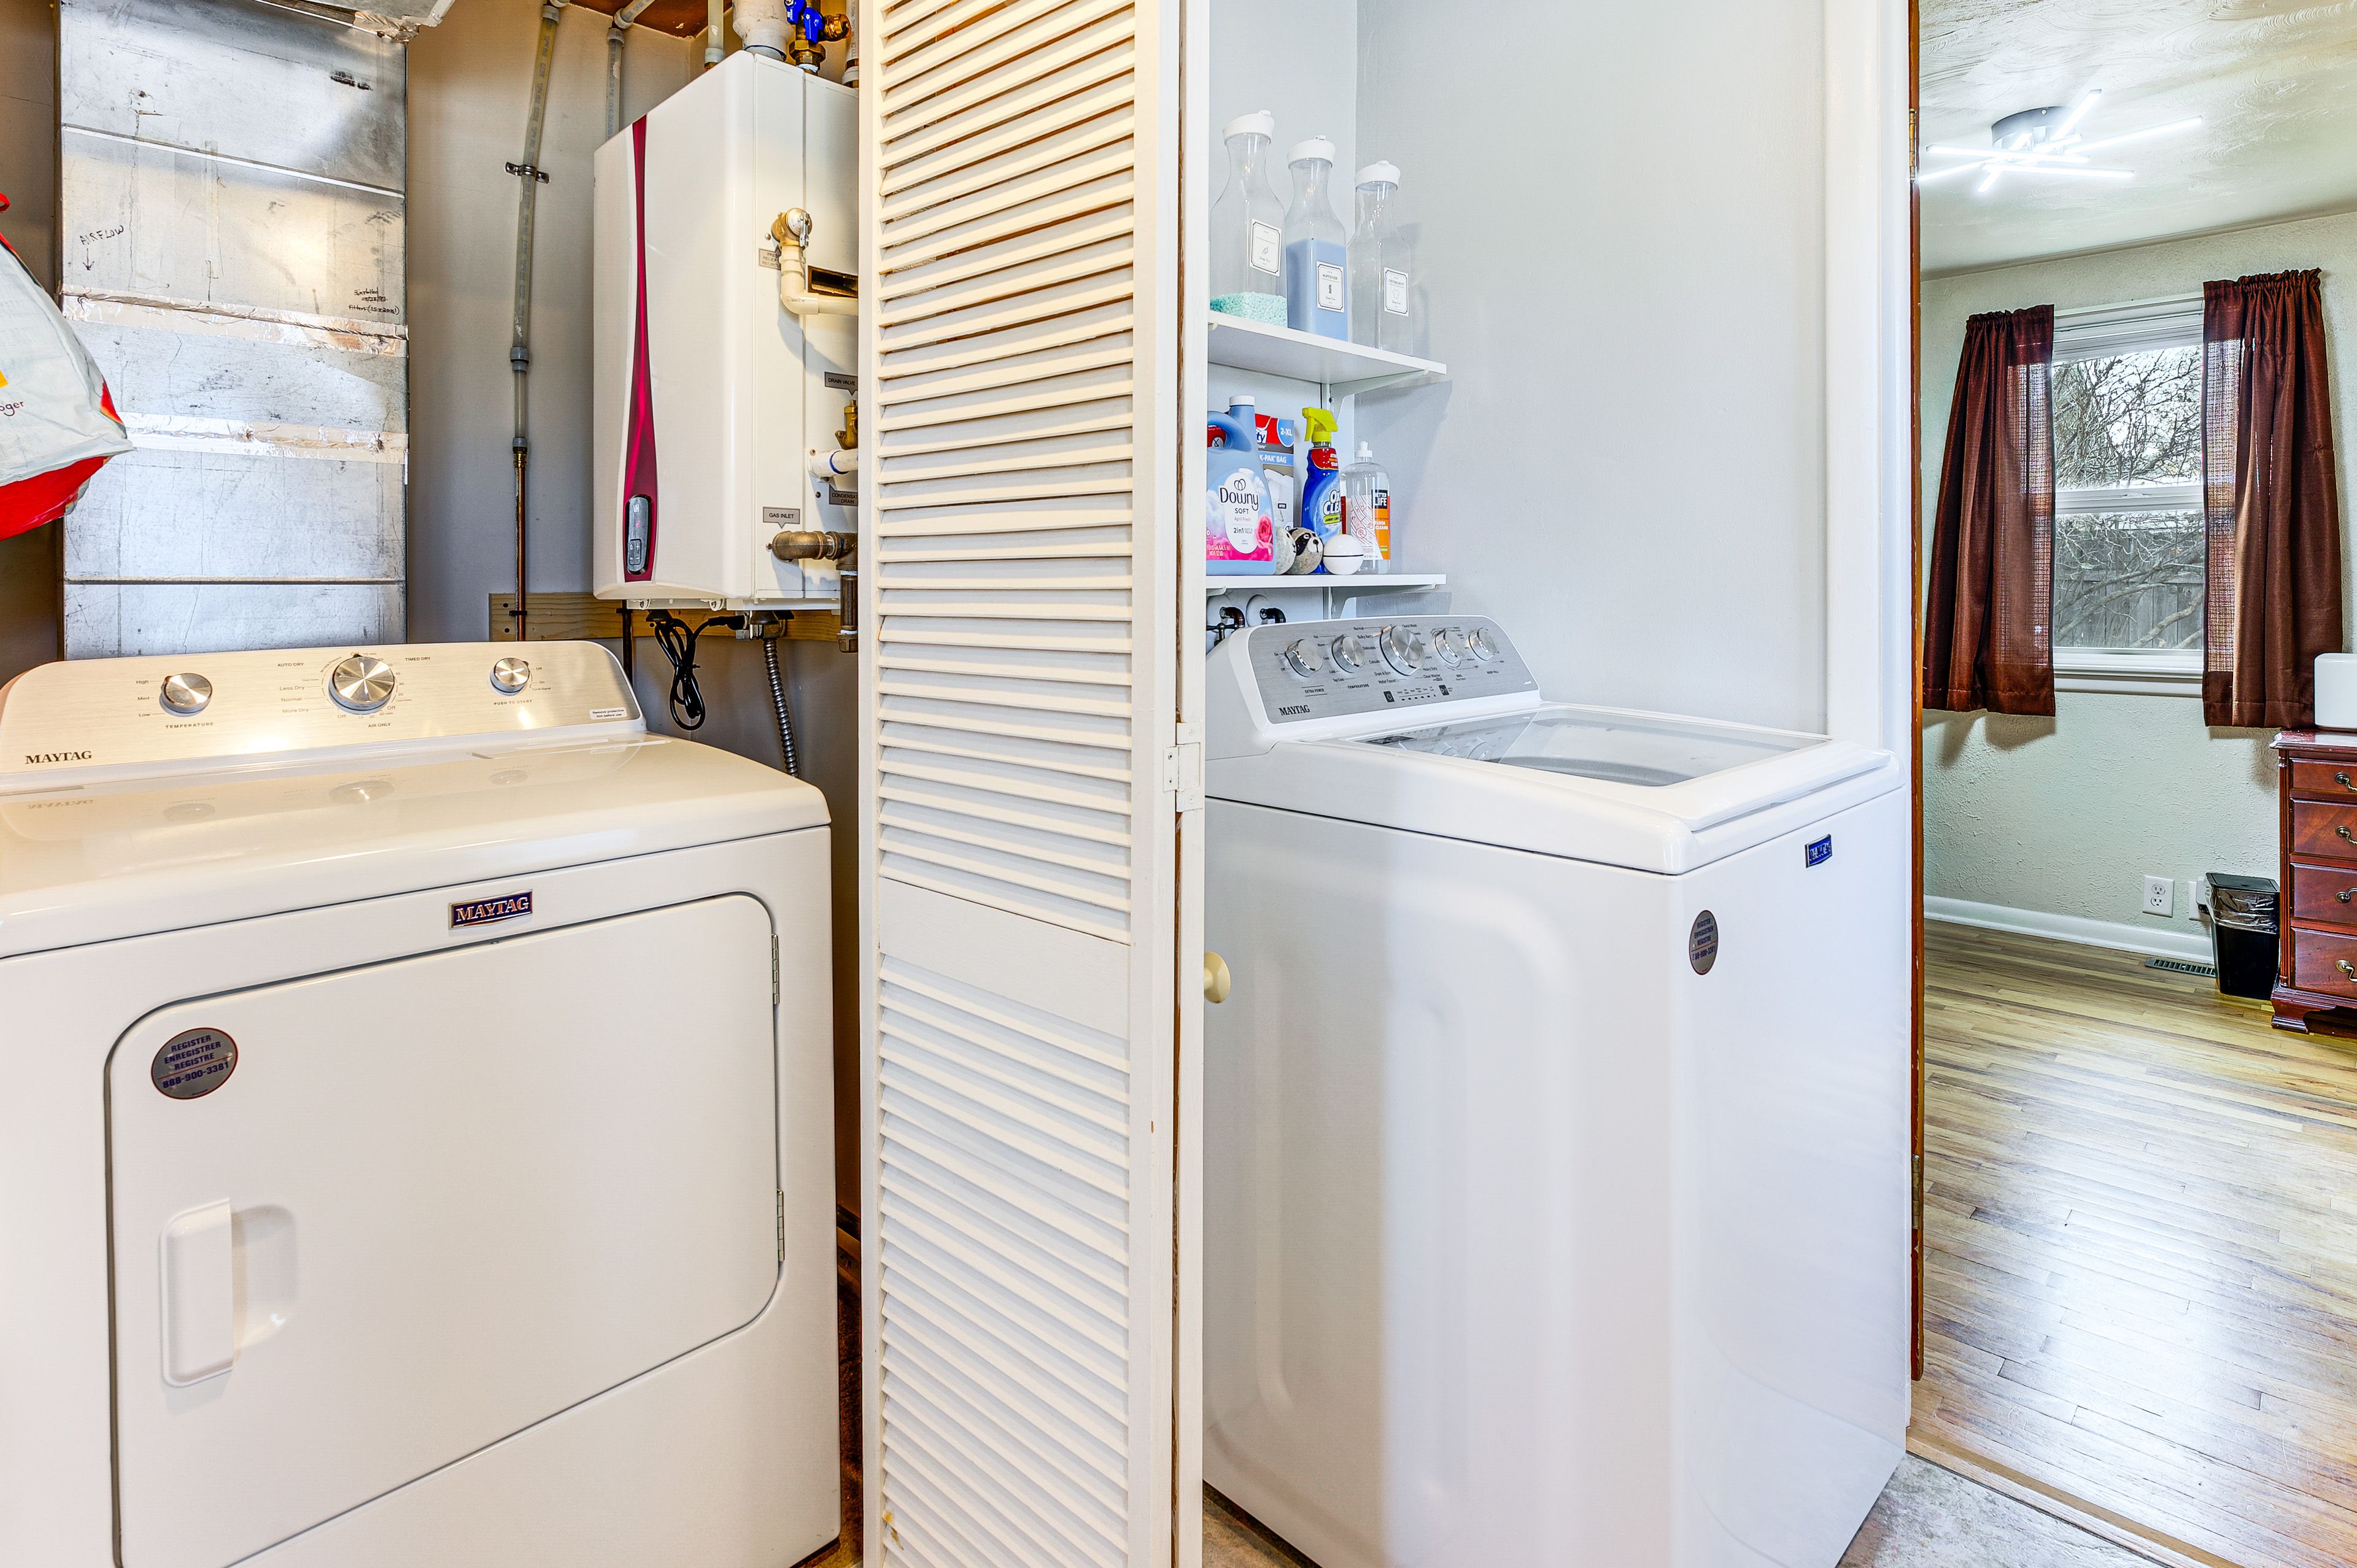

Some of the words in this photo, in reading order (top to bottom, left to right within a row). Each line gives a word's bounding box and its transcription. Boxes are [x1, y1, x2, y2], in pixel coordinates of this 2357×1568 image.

[79, 225, 124, 245] AIRFLOW
[1280, 427, 1293, 436] 2-XL
[1220, 487, 1259, 511] Downy
[1374, 497, 1387, 506] LIFE
[1279, 705, 1310, 716] MAYTAG
[25, 751, 93, 765] MAYTAG
[455, 897, 529, 922] MAYTAG
[164, 1041, 221, 1064] ENREGISTRER
[171, 1035, 212, 1052] REGISTER
[174, 1052, 215, 1070] REGISTRE
[163, 1061, 230, 1089] 888-900-3381
